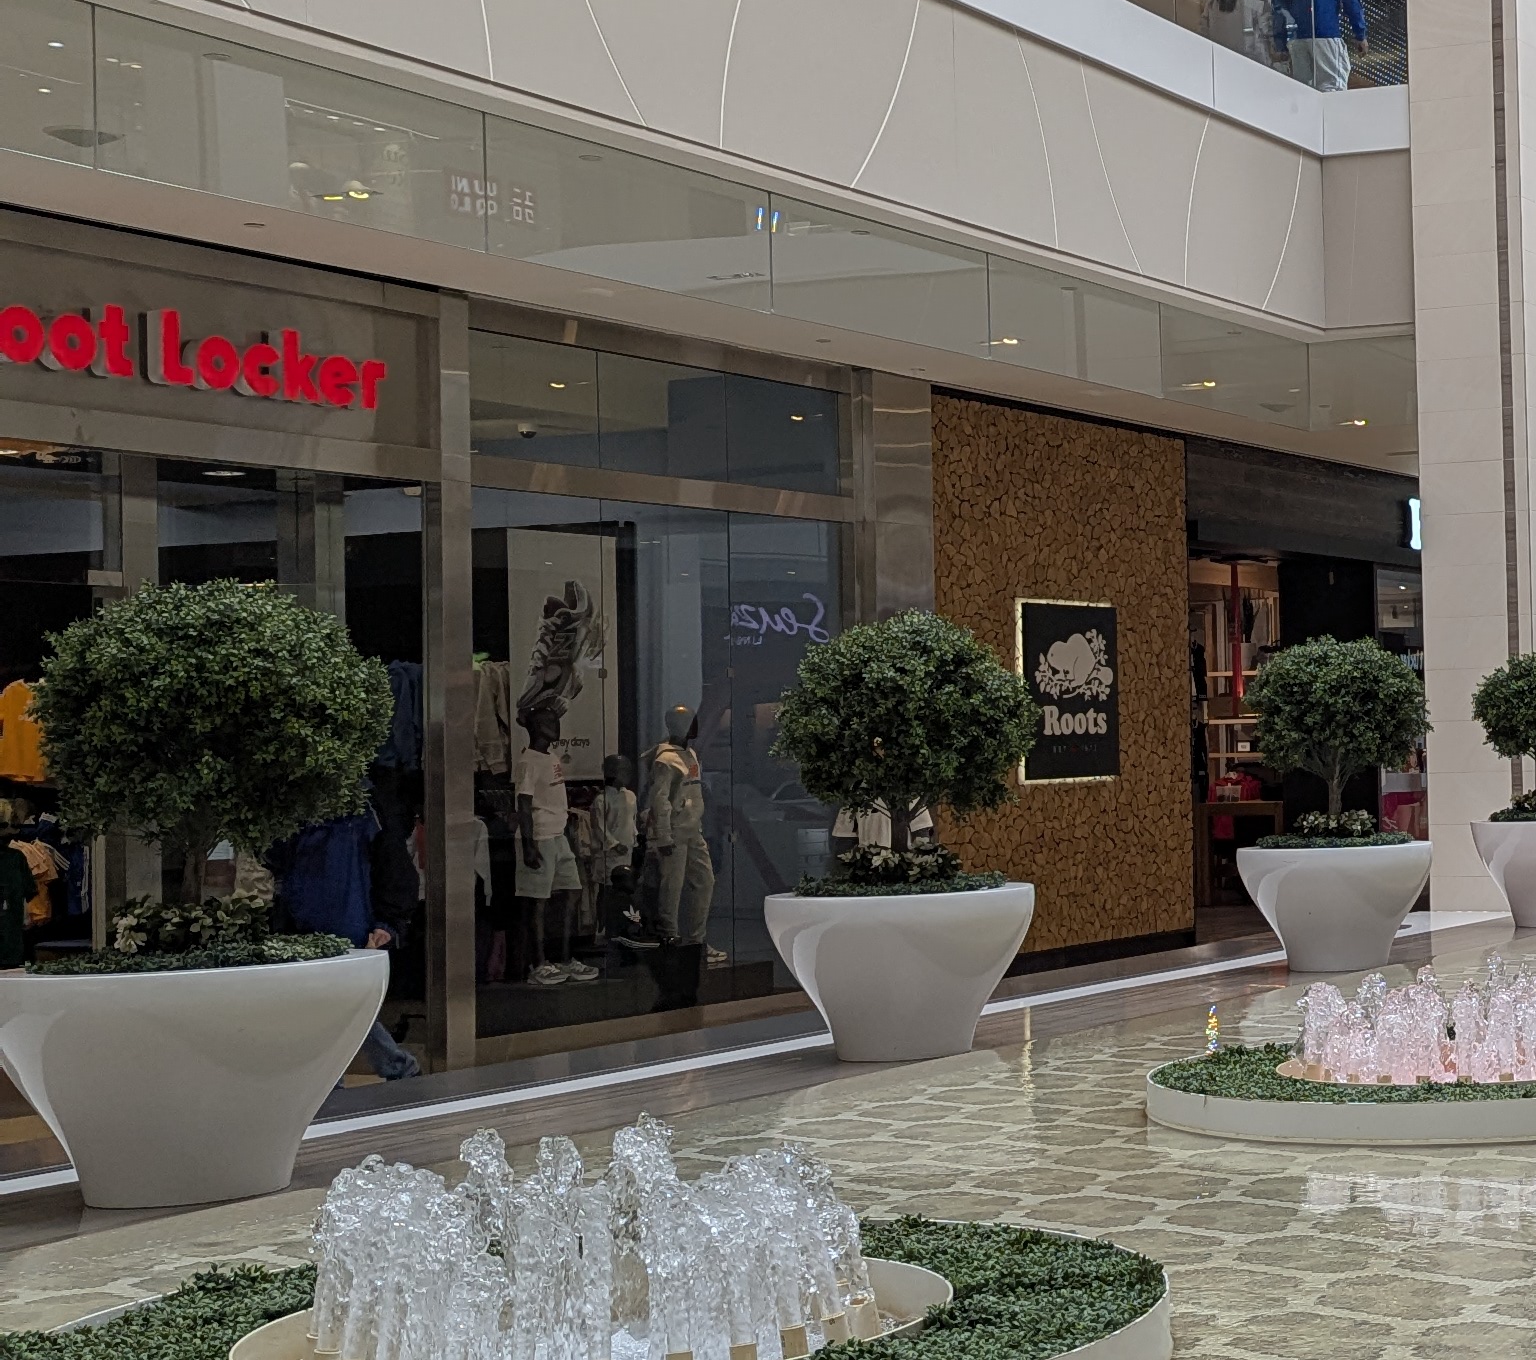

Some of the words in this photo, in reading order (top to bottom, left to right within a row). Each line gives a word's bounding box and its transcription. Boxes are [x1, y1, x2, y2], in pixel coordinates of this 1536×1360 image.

[0, 304, 134, 378] oot
[161, 309, 387, 410] Locker
[1043, 705, 1108, 736] Roots
